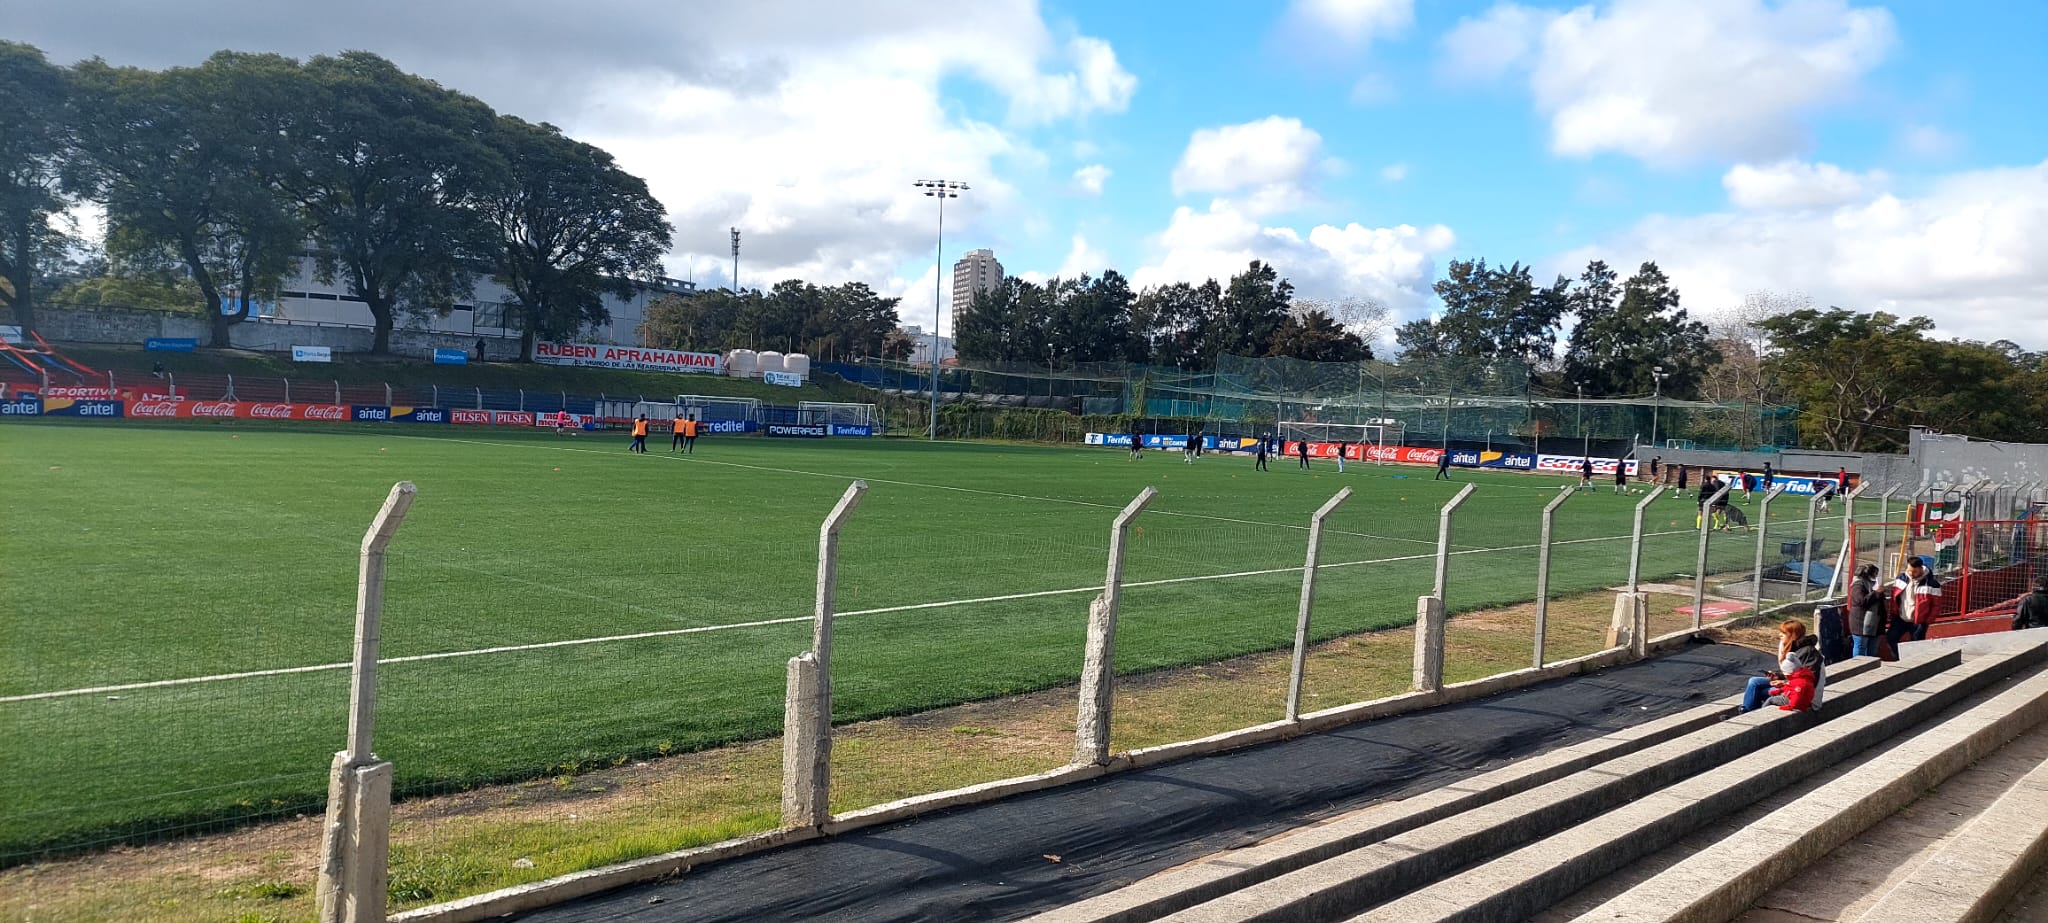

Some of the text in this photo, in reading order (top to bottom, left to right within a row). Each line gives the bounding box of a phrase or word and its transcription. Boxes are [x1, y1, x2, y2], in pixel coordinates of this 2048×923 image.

[537, 343, 715, 367] RUBEN APRAHAMIAN
[38, 387, 118, 396] DEPORTIVO
[1, 400, 38, 415] antel
[79, 402, 114, 416] antel
[358, 407, 386, 420] antel
[416, 410, 442, 422] antel
[452, 412, 488, 423] PILSEN
[496, 413, 532, 424] PILSEN
[709, 420, 745, 433] reditel
[769, 425, 824, 436] POWERADE
[837, 426, 867, 436] Tenfield
[1107, 435, 1132, 445] Tenfie
[1218, 439, 1238, 449] antel
[1452, 452, 1477, 464] antel
[1504, 455, 1531, 467] antel
